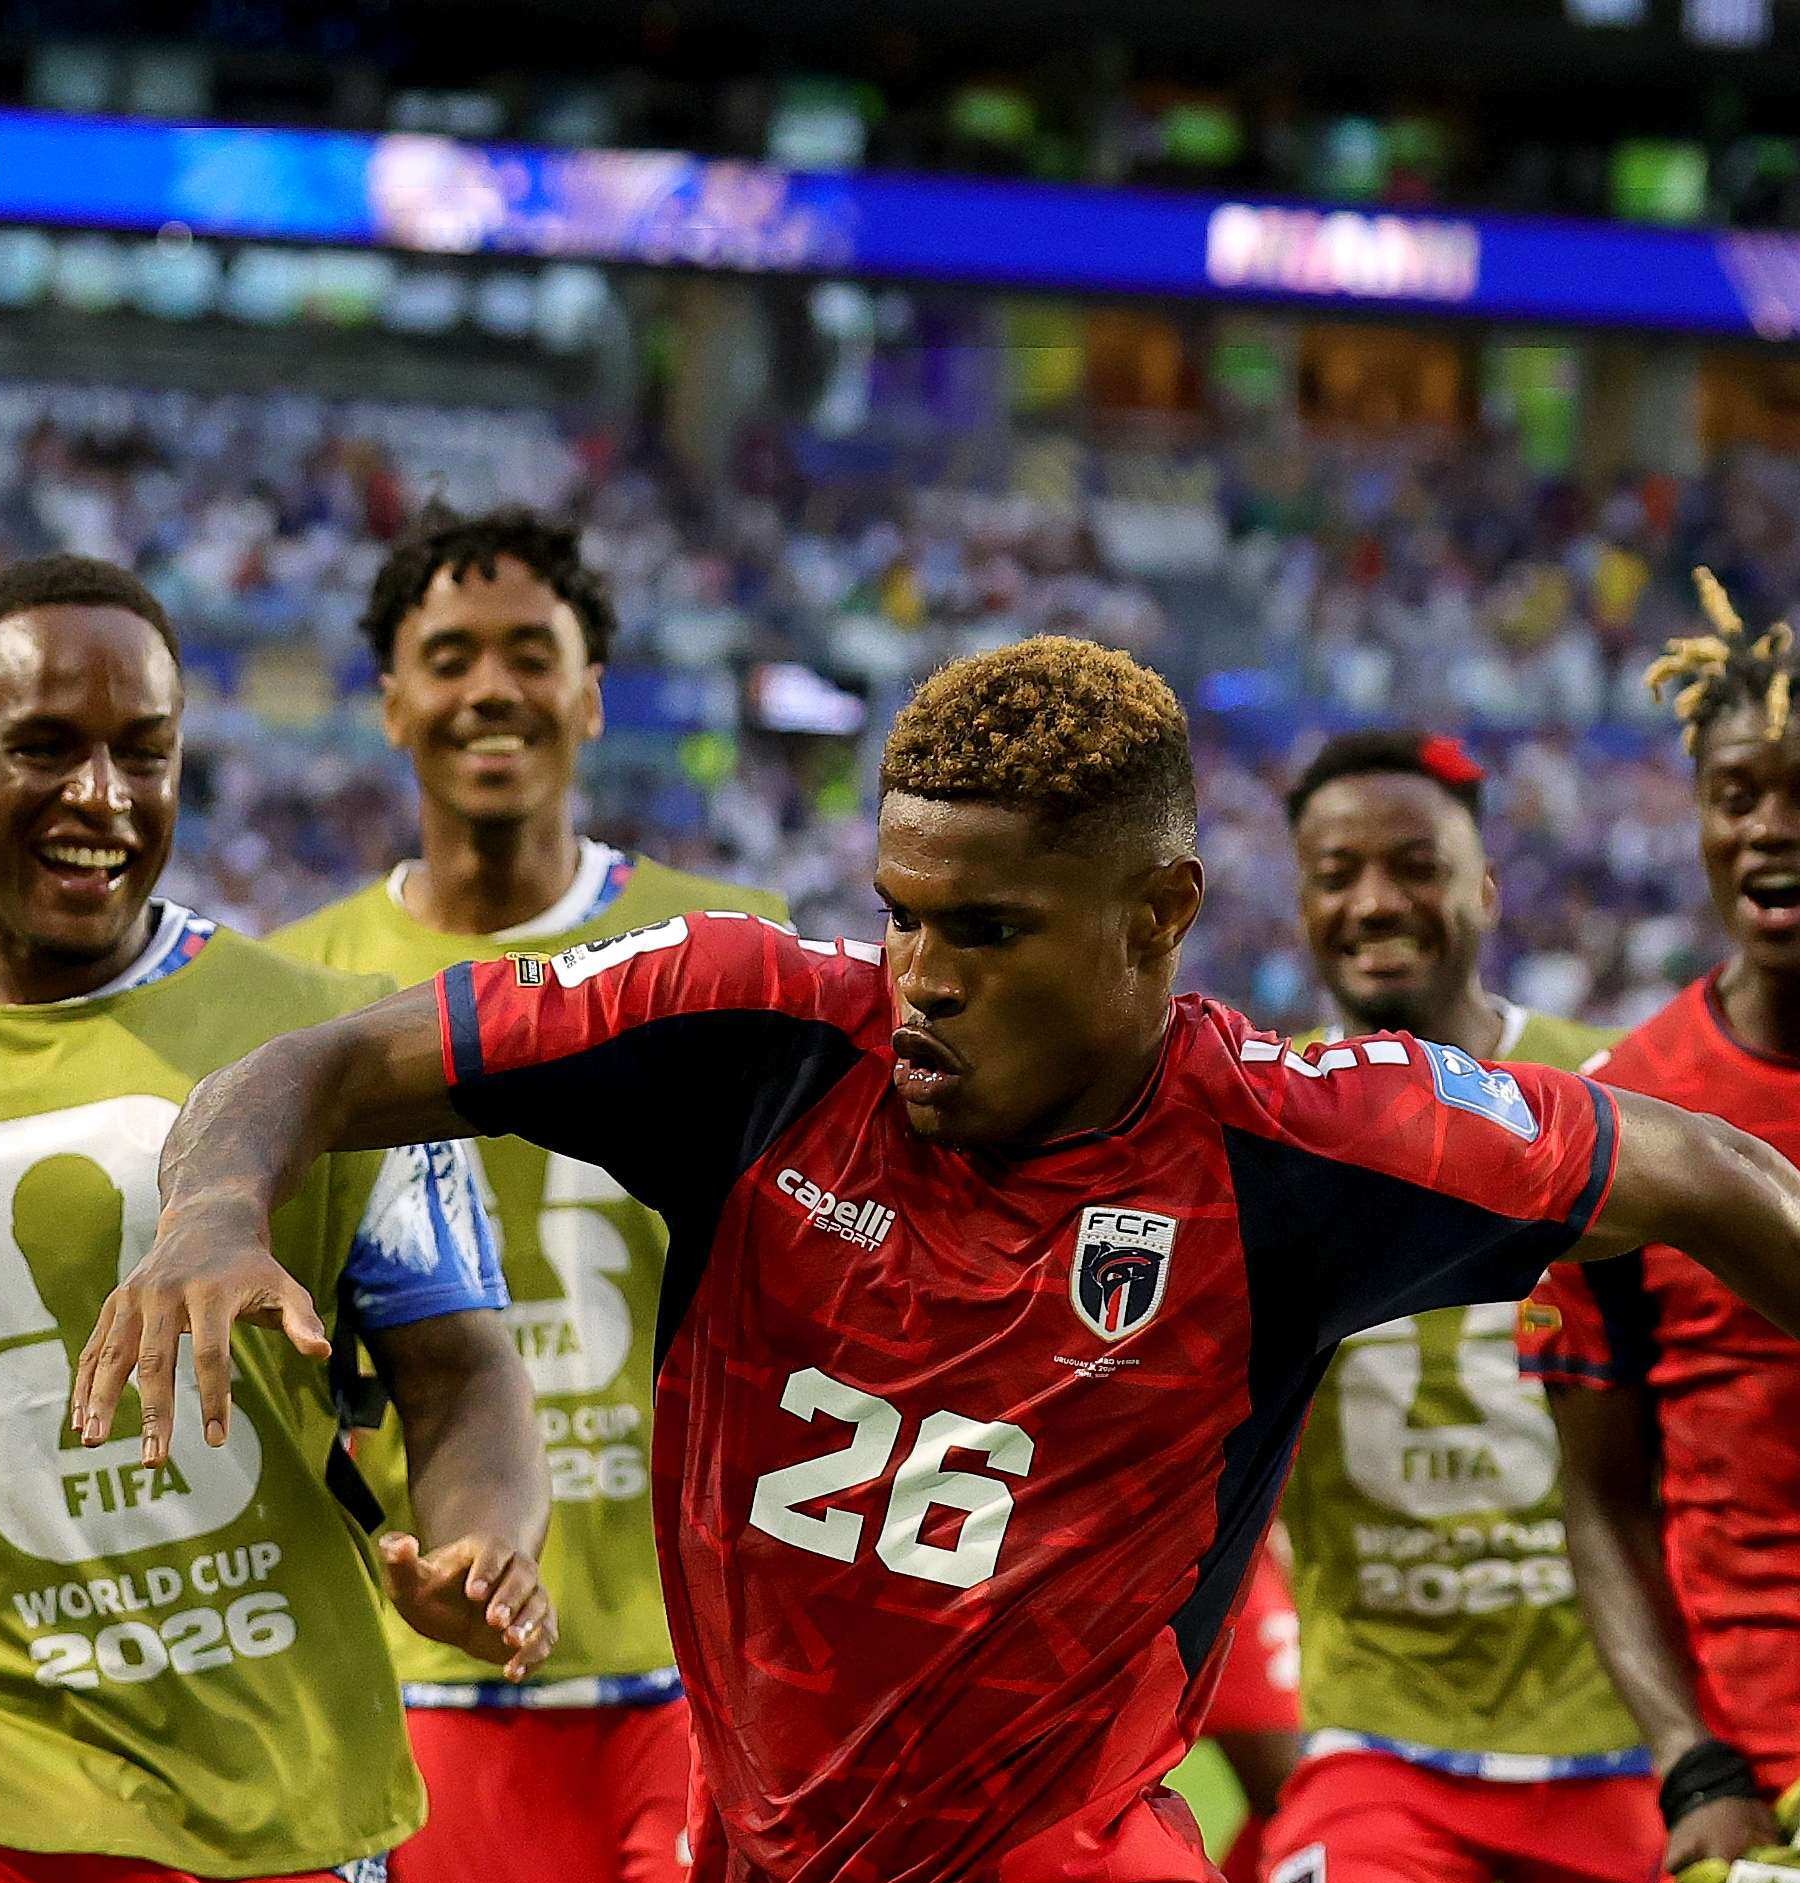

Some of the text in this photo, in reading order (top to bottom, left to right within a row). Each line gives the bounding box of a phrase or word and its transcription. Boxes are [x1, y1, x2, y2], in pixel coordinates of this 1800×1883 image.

[777, 1168, 896, 1243] capelli
[814, 1216, 881, 1252] SPORT
[1088, 1213, 1169, 1237] FCF
[61, 1459, 192, 1518] FIFA
[749, 1366, 1034, 1588] 26
[12, 1541, 283, 1629] WORLD CUP
[29, 1591, 297, 1690] 2026
